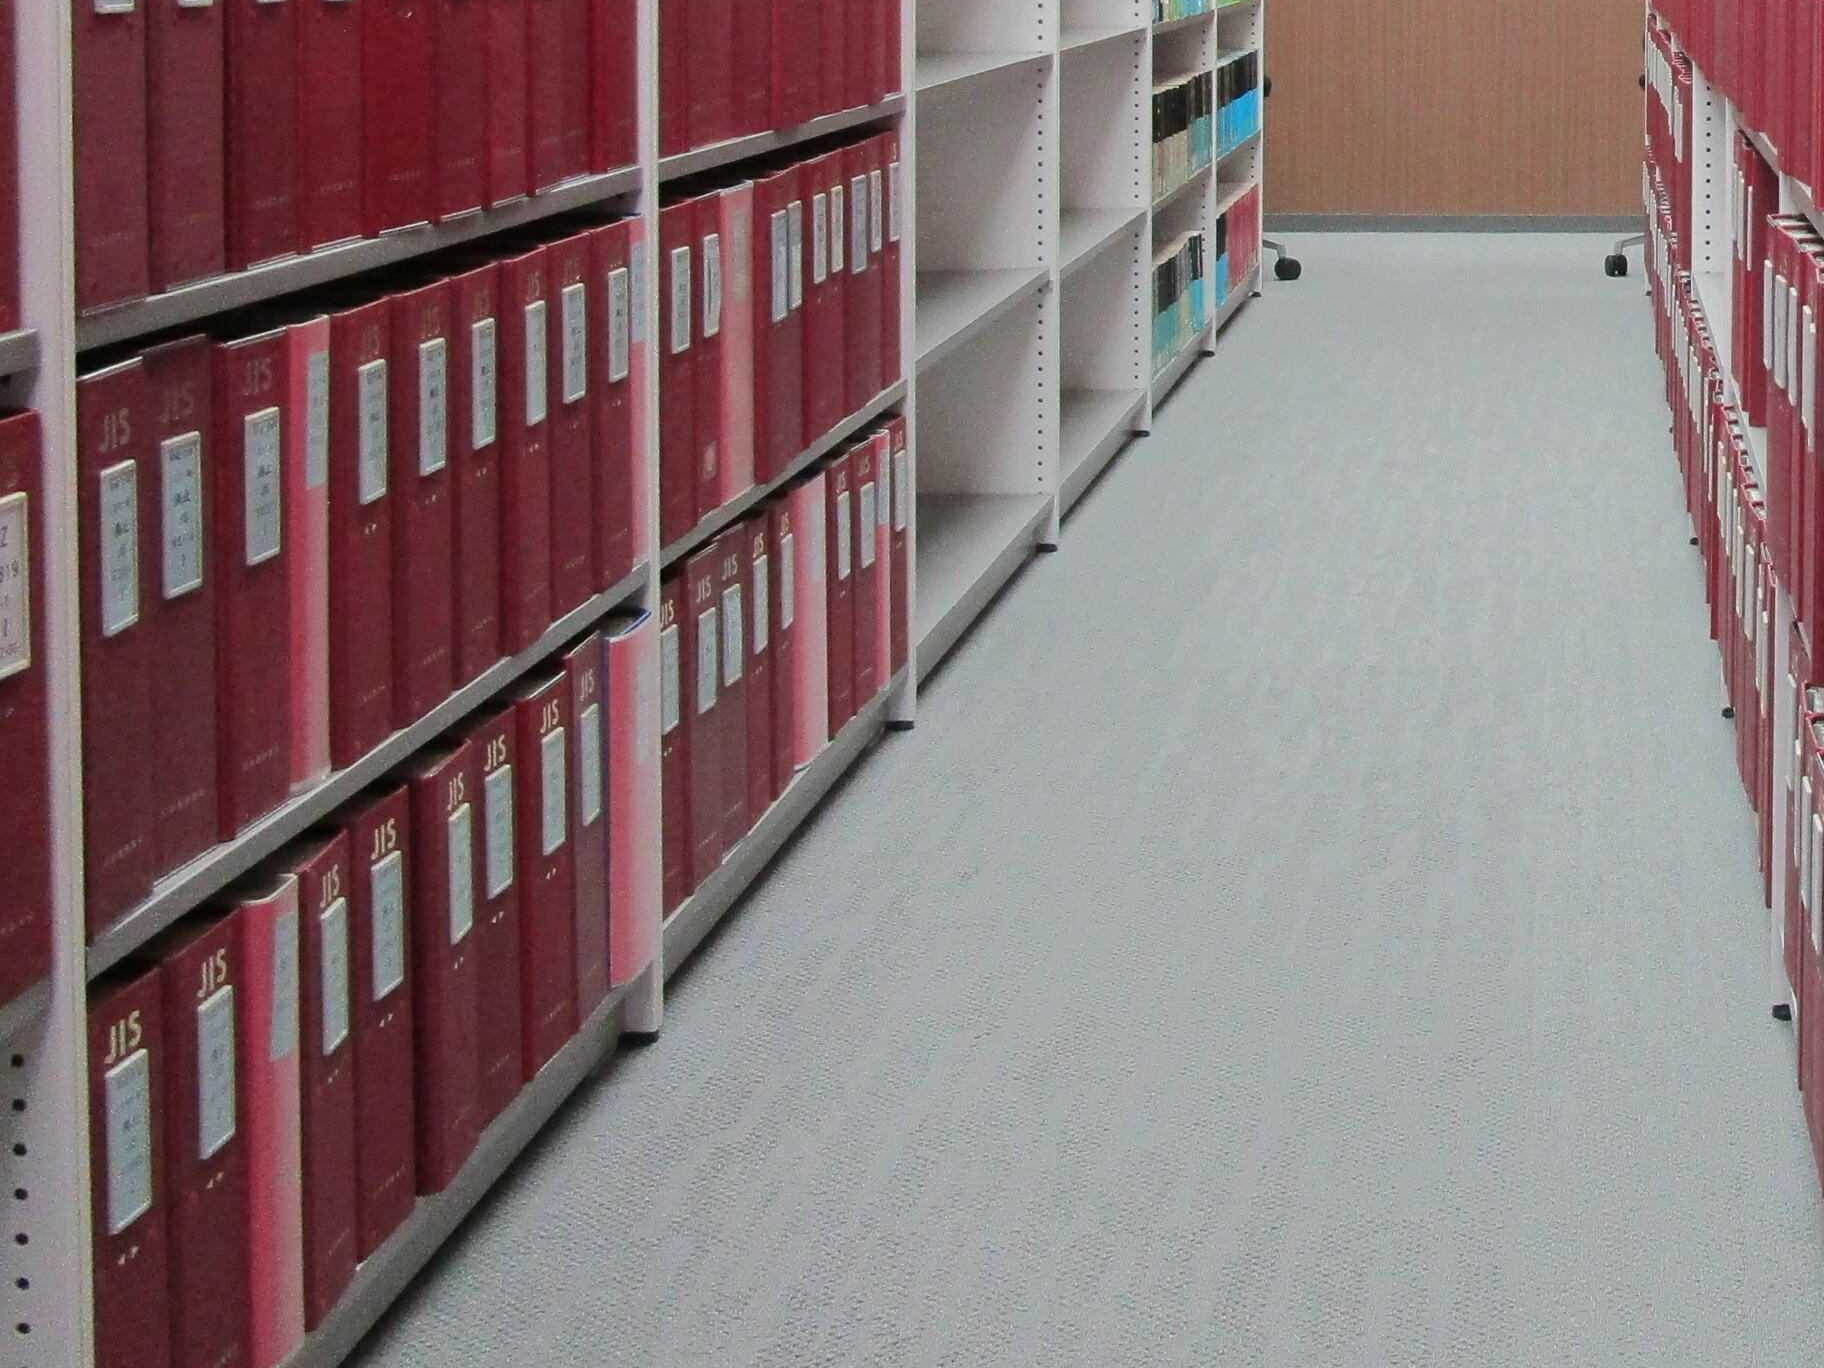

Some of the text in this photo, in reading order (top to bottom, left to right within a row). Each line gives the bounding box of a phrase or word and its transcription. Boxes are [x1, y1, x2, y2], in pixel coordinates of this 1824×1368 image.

[243, 358, 272, 396] JIS
[100, 408, 131, 453] JIS
[722, 553, 738, 581] JIS
[580, 668, 594, 702] JIS
[540, 699, 559, 733] JIS
[484, 734, 507, 772] JIS
[447, 772, 464, 811] JIS
[371, 818, 397, 860] JIS
[320, 864, 340, 908] JIS
[197, 947, 227, 998] JIS
[105, 1010, 142, 1064] JIS
